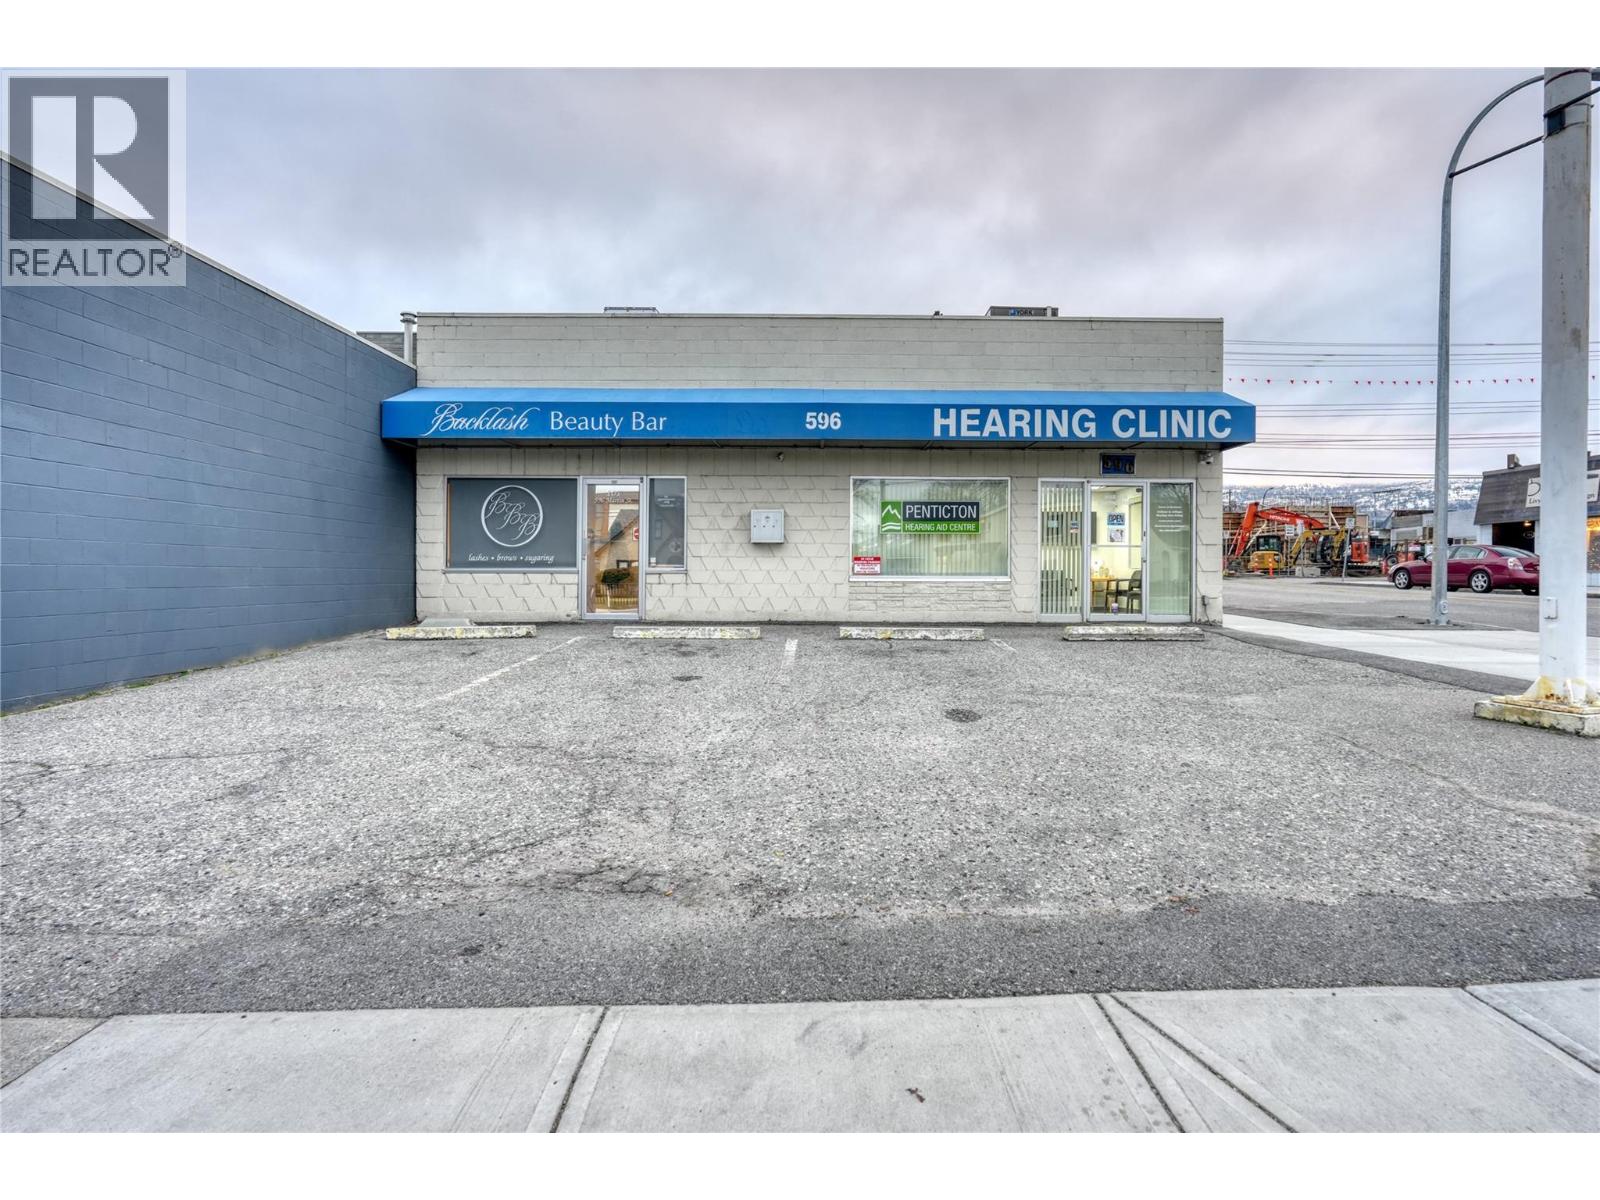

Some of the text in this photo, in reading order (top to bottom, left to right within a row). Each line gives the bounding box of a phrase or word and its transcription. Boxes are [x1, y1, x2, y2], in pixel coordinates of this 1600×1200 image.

[419, 403, 667, 437] Backlash Beauty Bar
[805, 412, 842, 430] 596
[932, 408, 1233, 437] HEARING CLINIC
[905, 504, 977, 519] PENTICTON
[905, 523, 976, 531] HEARING AID CENTRE
